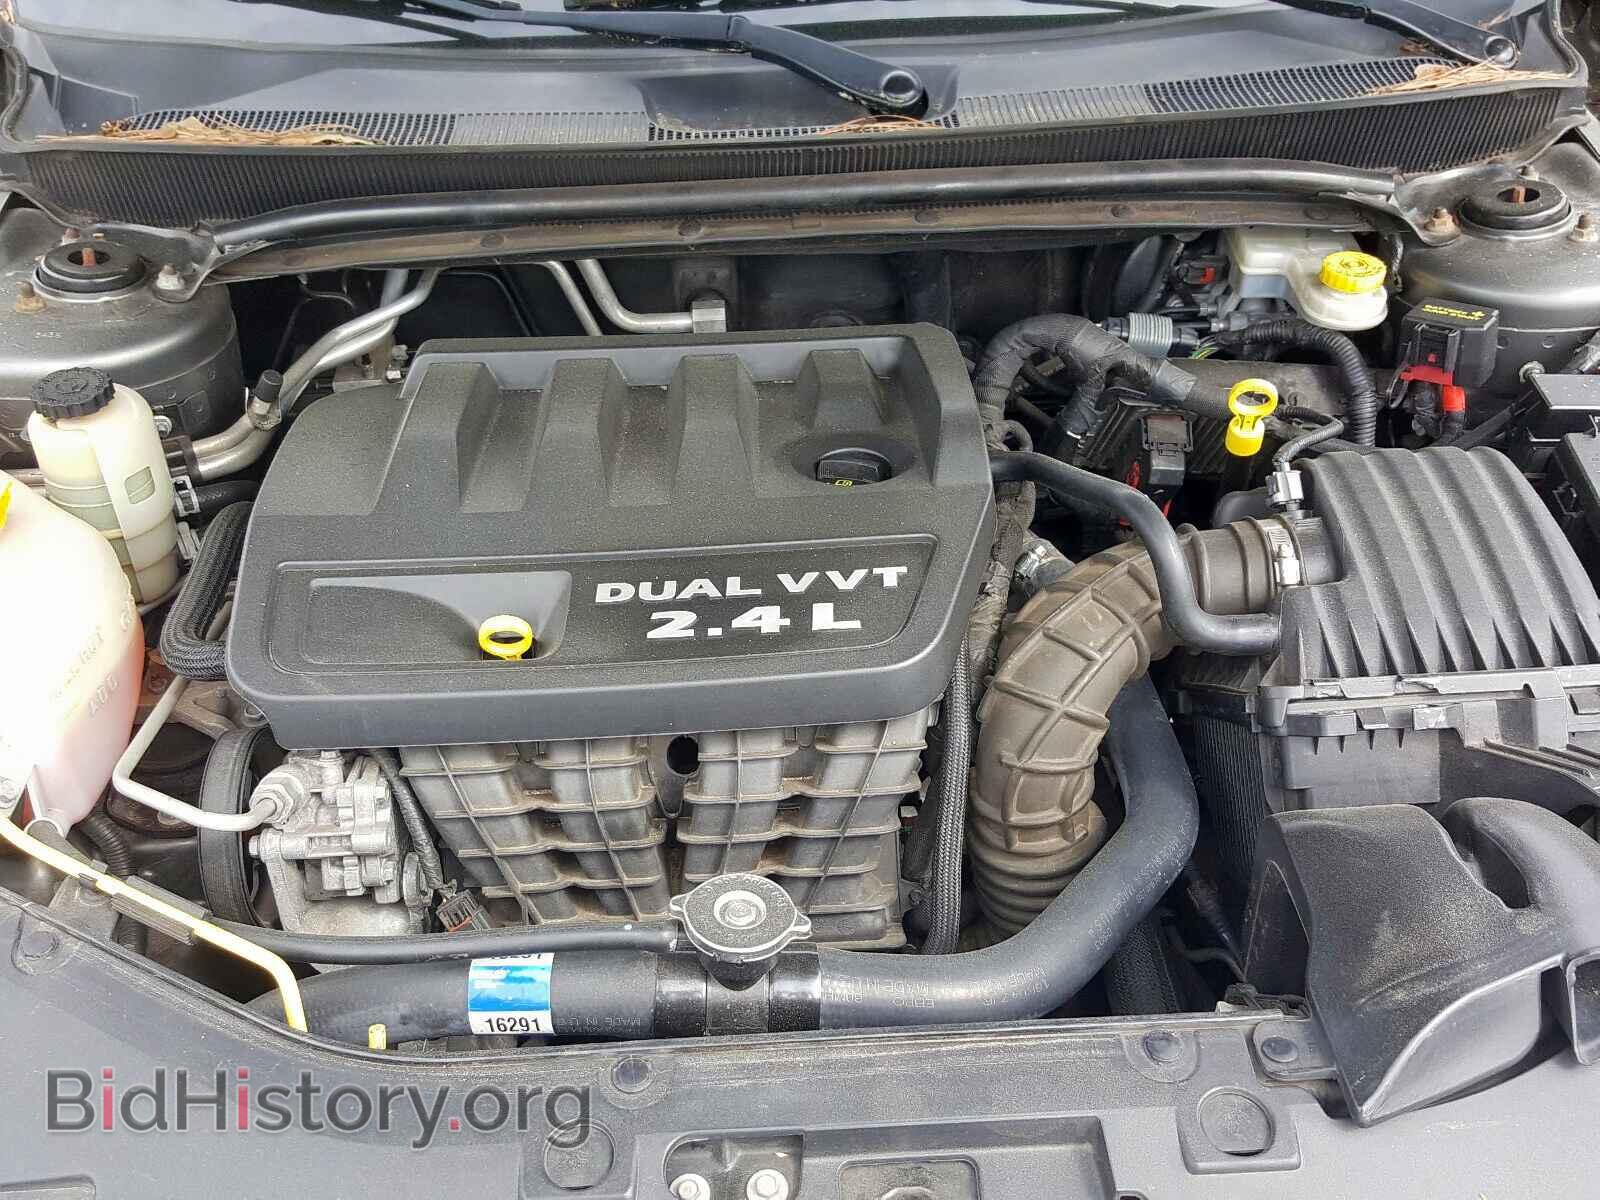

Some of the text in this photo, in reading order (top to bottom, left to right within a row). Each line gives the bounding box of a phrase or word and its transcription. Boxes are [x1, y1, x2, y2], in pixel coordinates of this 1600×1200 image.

[595, 565, 908, 603] DUAL VVT
[646, 602, 862, 639] 2.4 L
[484, 1016, 541, 1033] 16291
